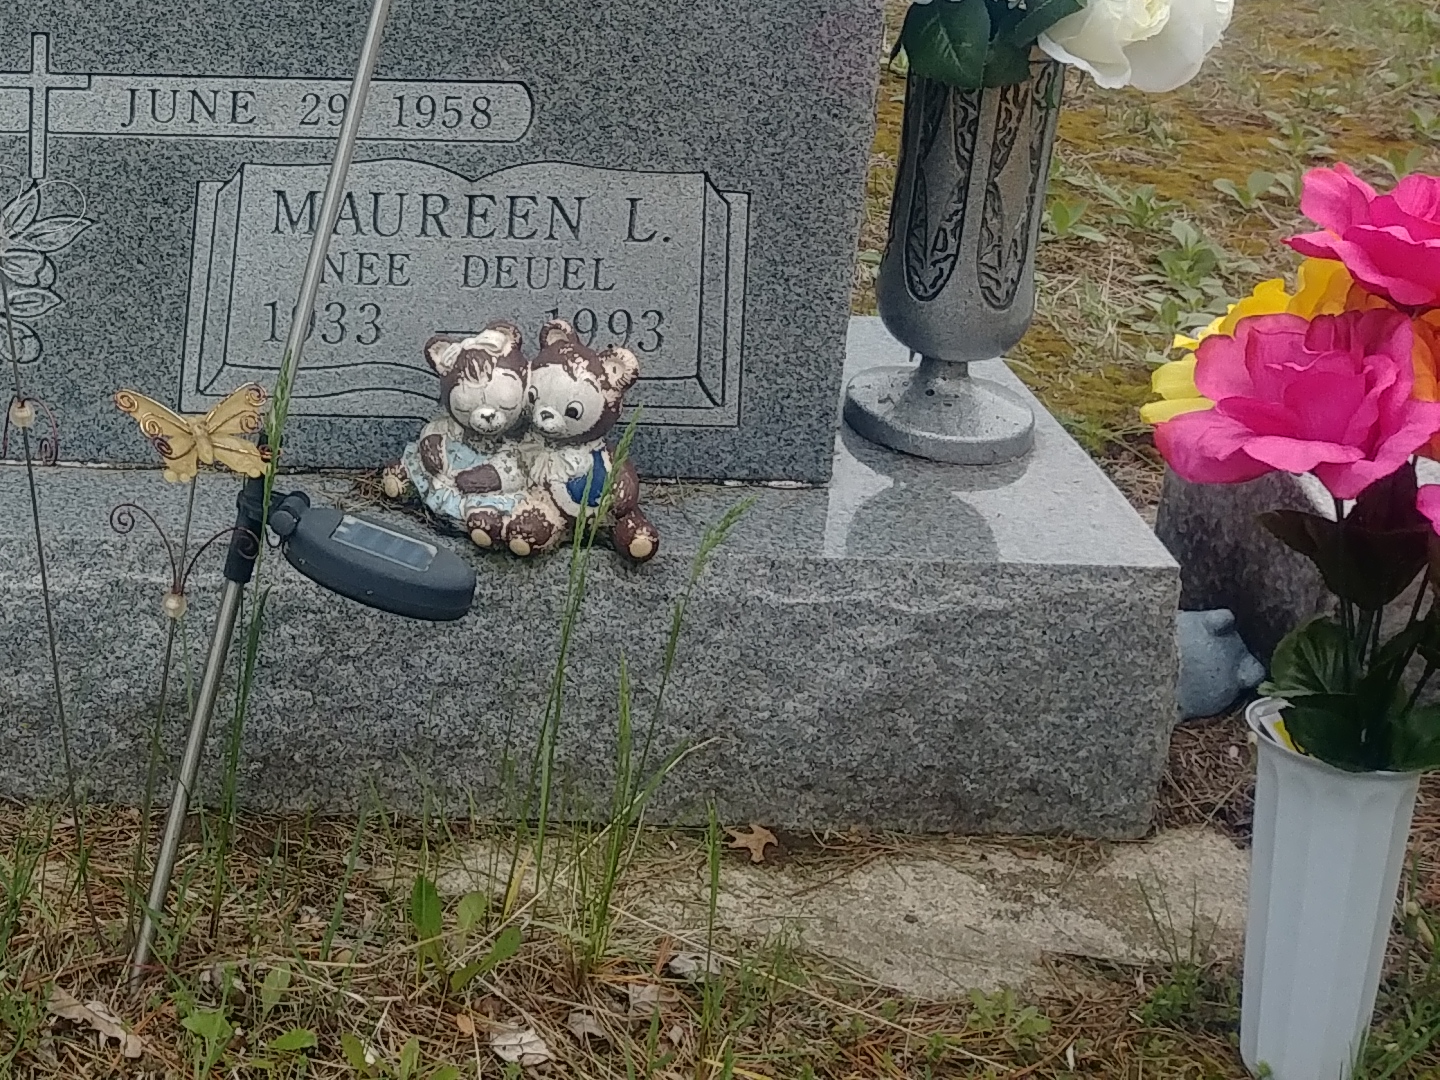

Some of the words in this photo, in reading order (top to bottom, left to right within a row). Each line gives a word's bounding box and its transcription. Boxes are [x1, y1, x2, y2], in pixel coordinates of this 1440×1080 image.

[120, 88, 257, 128] JUNE
[392, 94, 492, 129] 1958
[271, 190, 587, 241] MAUREEN
[623, 197, 671, 243] L.
[319, 251, 411, 286] NEE
[460, 255, 615, 291] DEUEL
[545, 308, 664, 352] 993
